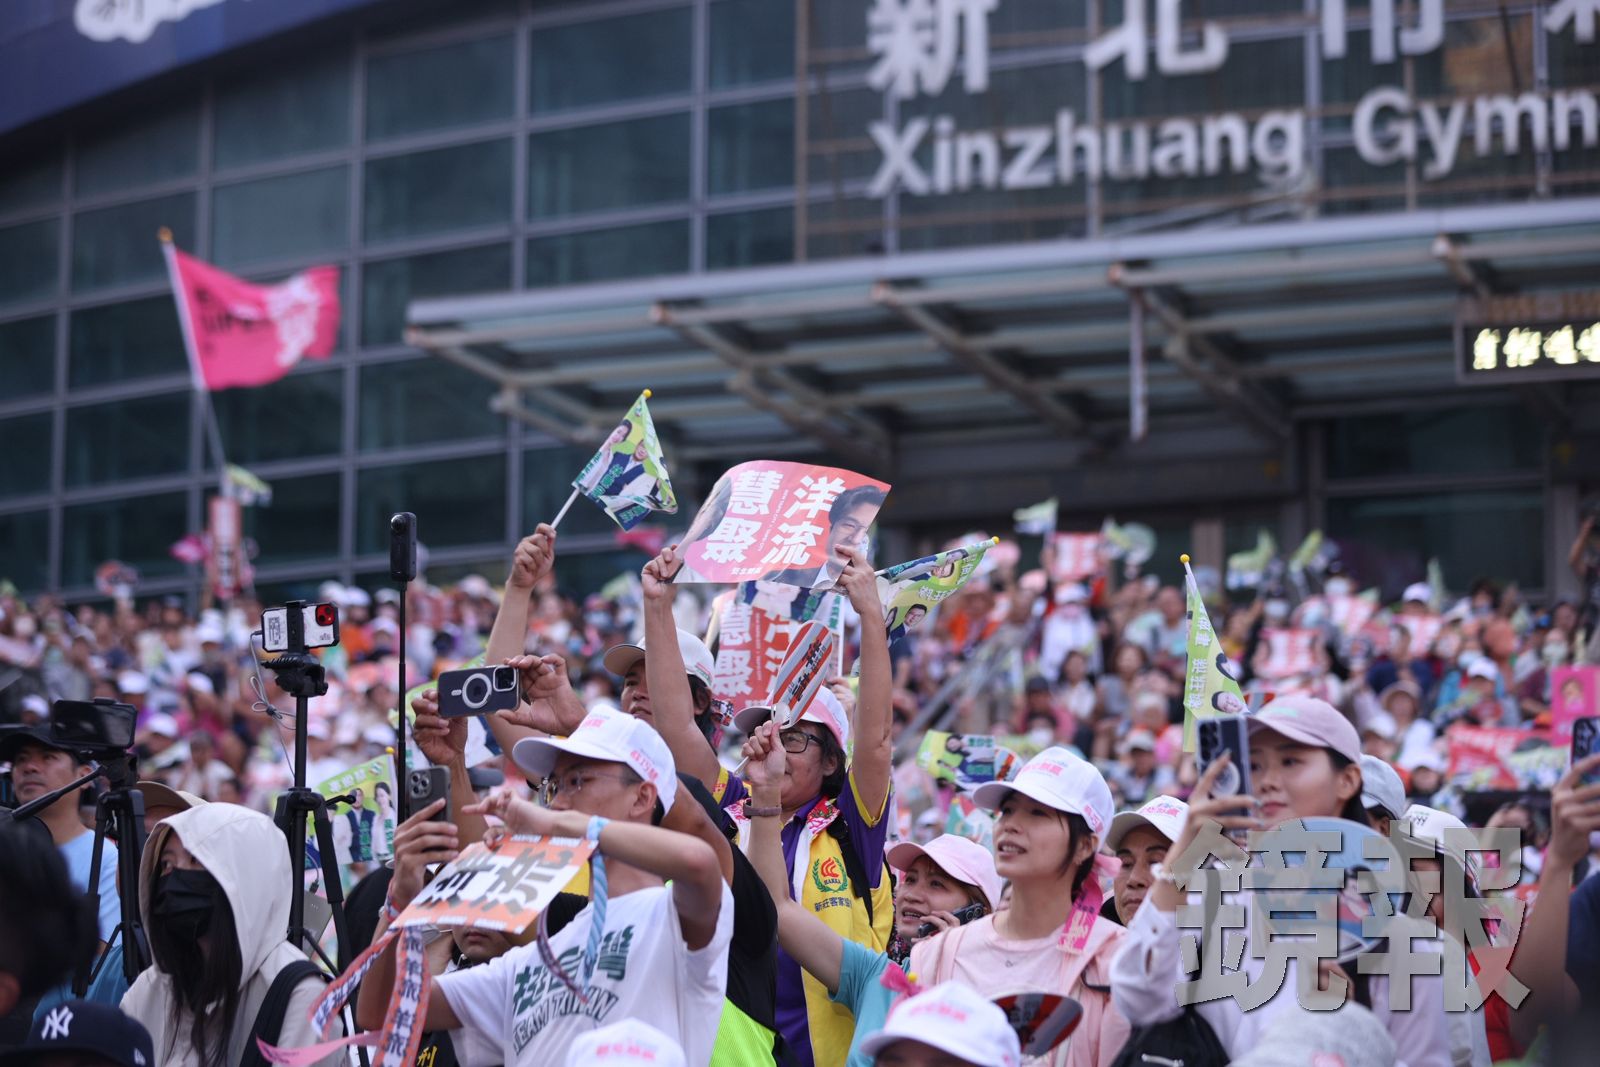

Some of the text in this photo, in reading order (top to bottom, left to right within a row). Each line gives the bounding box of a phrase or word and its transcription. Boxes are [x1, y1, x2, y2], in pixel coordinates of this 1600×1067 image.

[868, 107, 1306, 195] Xinzhuang
[701, 469, 784, 564] 慧聚
[761, 474, 847, 566] 洋流
